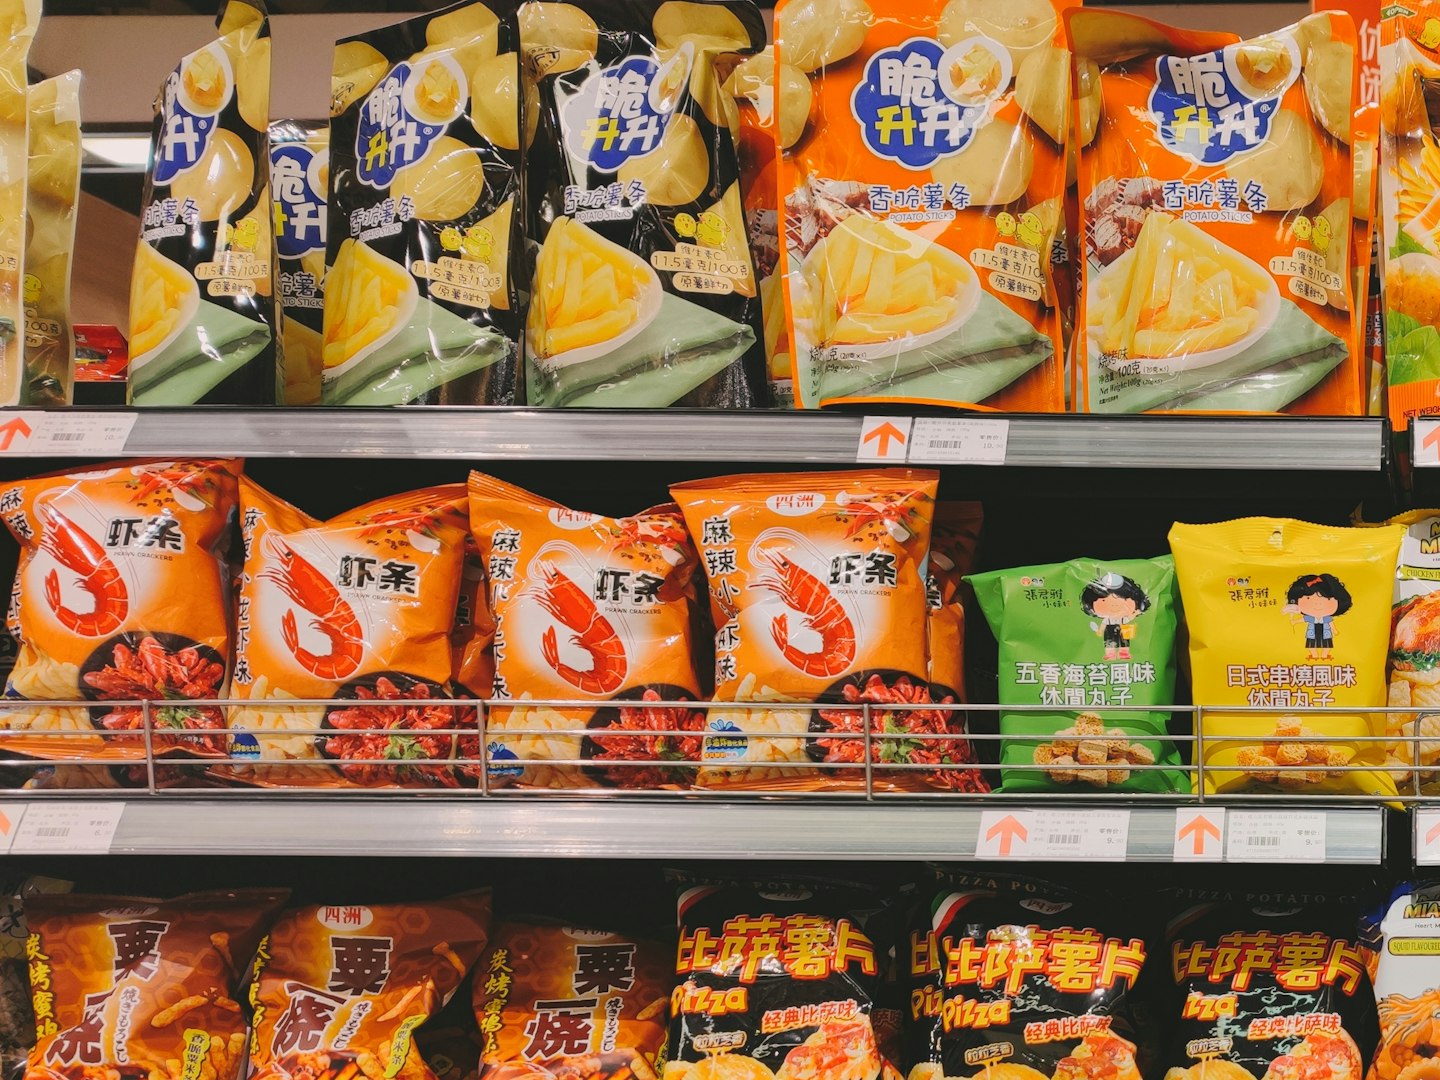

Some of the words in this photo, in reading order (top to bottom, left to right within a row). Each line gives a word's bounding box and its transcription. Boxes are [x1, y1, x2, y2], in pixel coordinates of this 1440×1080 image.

[879, 50, 937, 109] 脆
[875, 105, 963, 147] 升升
[1173, 106, 1258, 145] 升升
[869, 183, 970, 210] 香脆薯条
[1163, 180, 1268, 211] 香脆薯条
[890, 212, 925, 222] POTATO
[927, 210, 955, 221] STICKS
[1184, 212, 1217, 222] POTATO
[1220, 212, 1252, 223] STICKS
[106, 516, 184, 551] 虾条
[338, 553, 421, 596] 虾条
[828, 554, 898, 587] 虾条
[1406, 568, 1434, 579] CHICKEN
[1025, 589, 1063, 600] 張君雅
[1229, 589, 1269, 602] 張君雅
[1015, 662, 1156, 686] 五香海苔風味
[1227, 664, 1357, 688] 日式串燒風味
[324, 907, 367, 925] 四洲
[676, 916, 878, 982] 比萨薯片
[943, 926, 1148, 992] 比萨薯片
[1393, 942, 1410, 951] SQUID
[1174, 934, 1364, 995] 比萨薯片
[671, 986, 748, 1016] Pizza
[943, 998, 1011, 1029] Pizza
[762, 1001, 855, 1032] 经典比萨味
[1025, 1015, 1112, 1043] 经典比萨味
[1249, 1013, 1341, 1038] 经典比萨味
